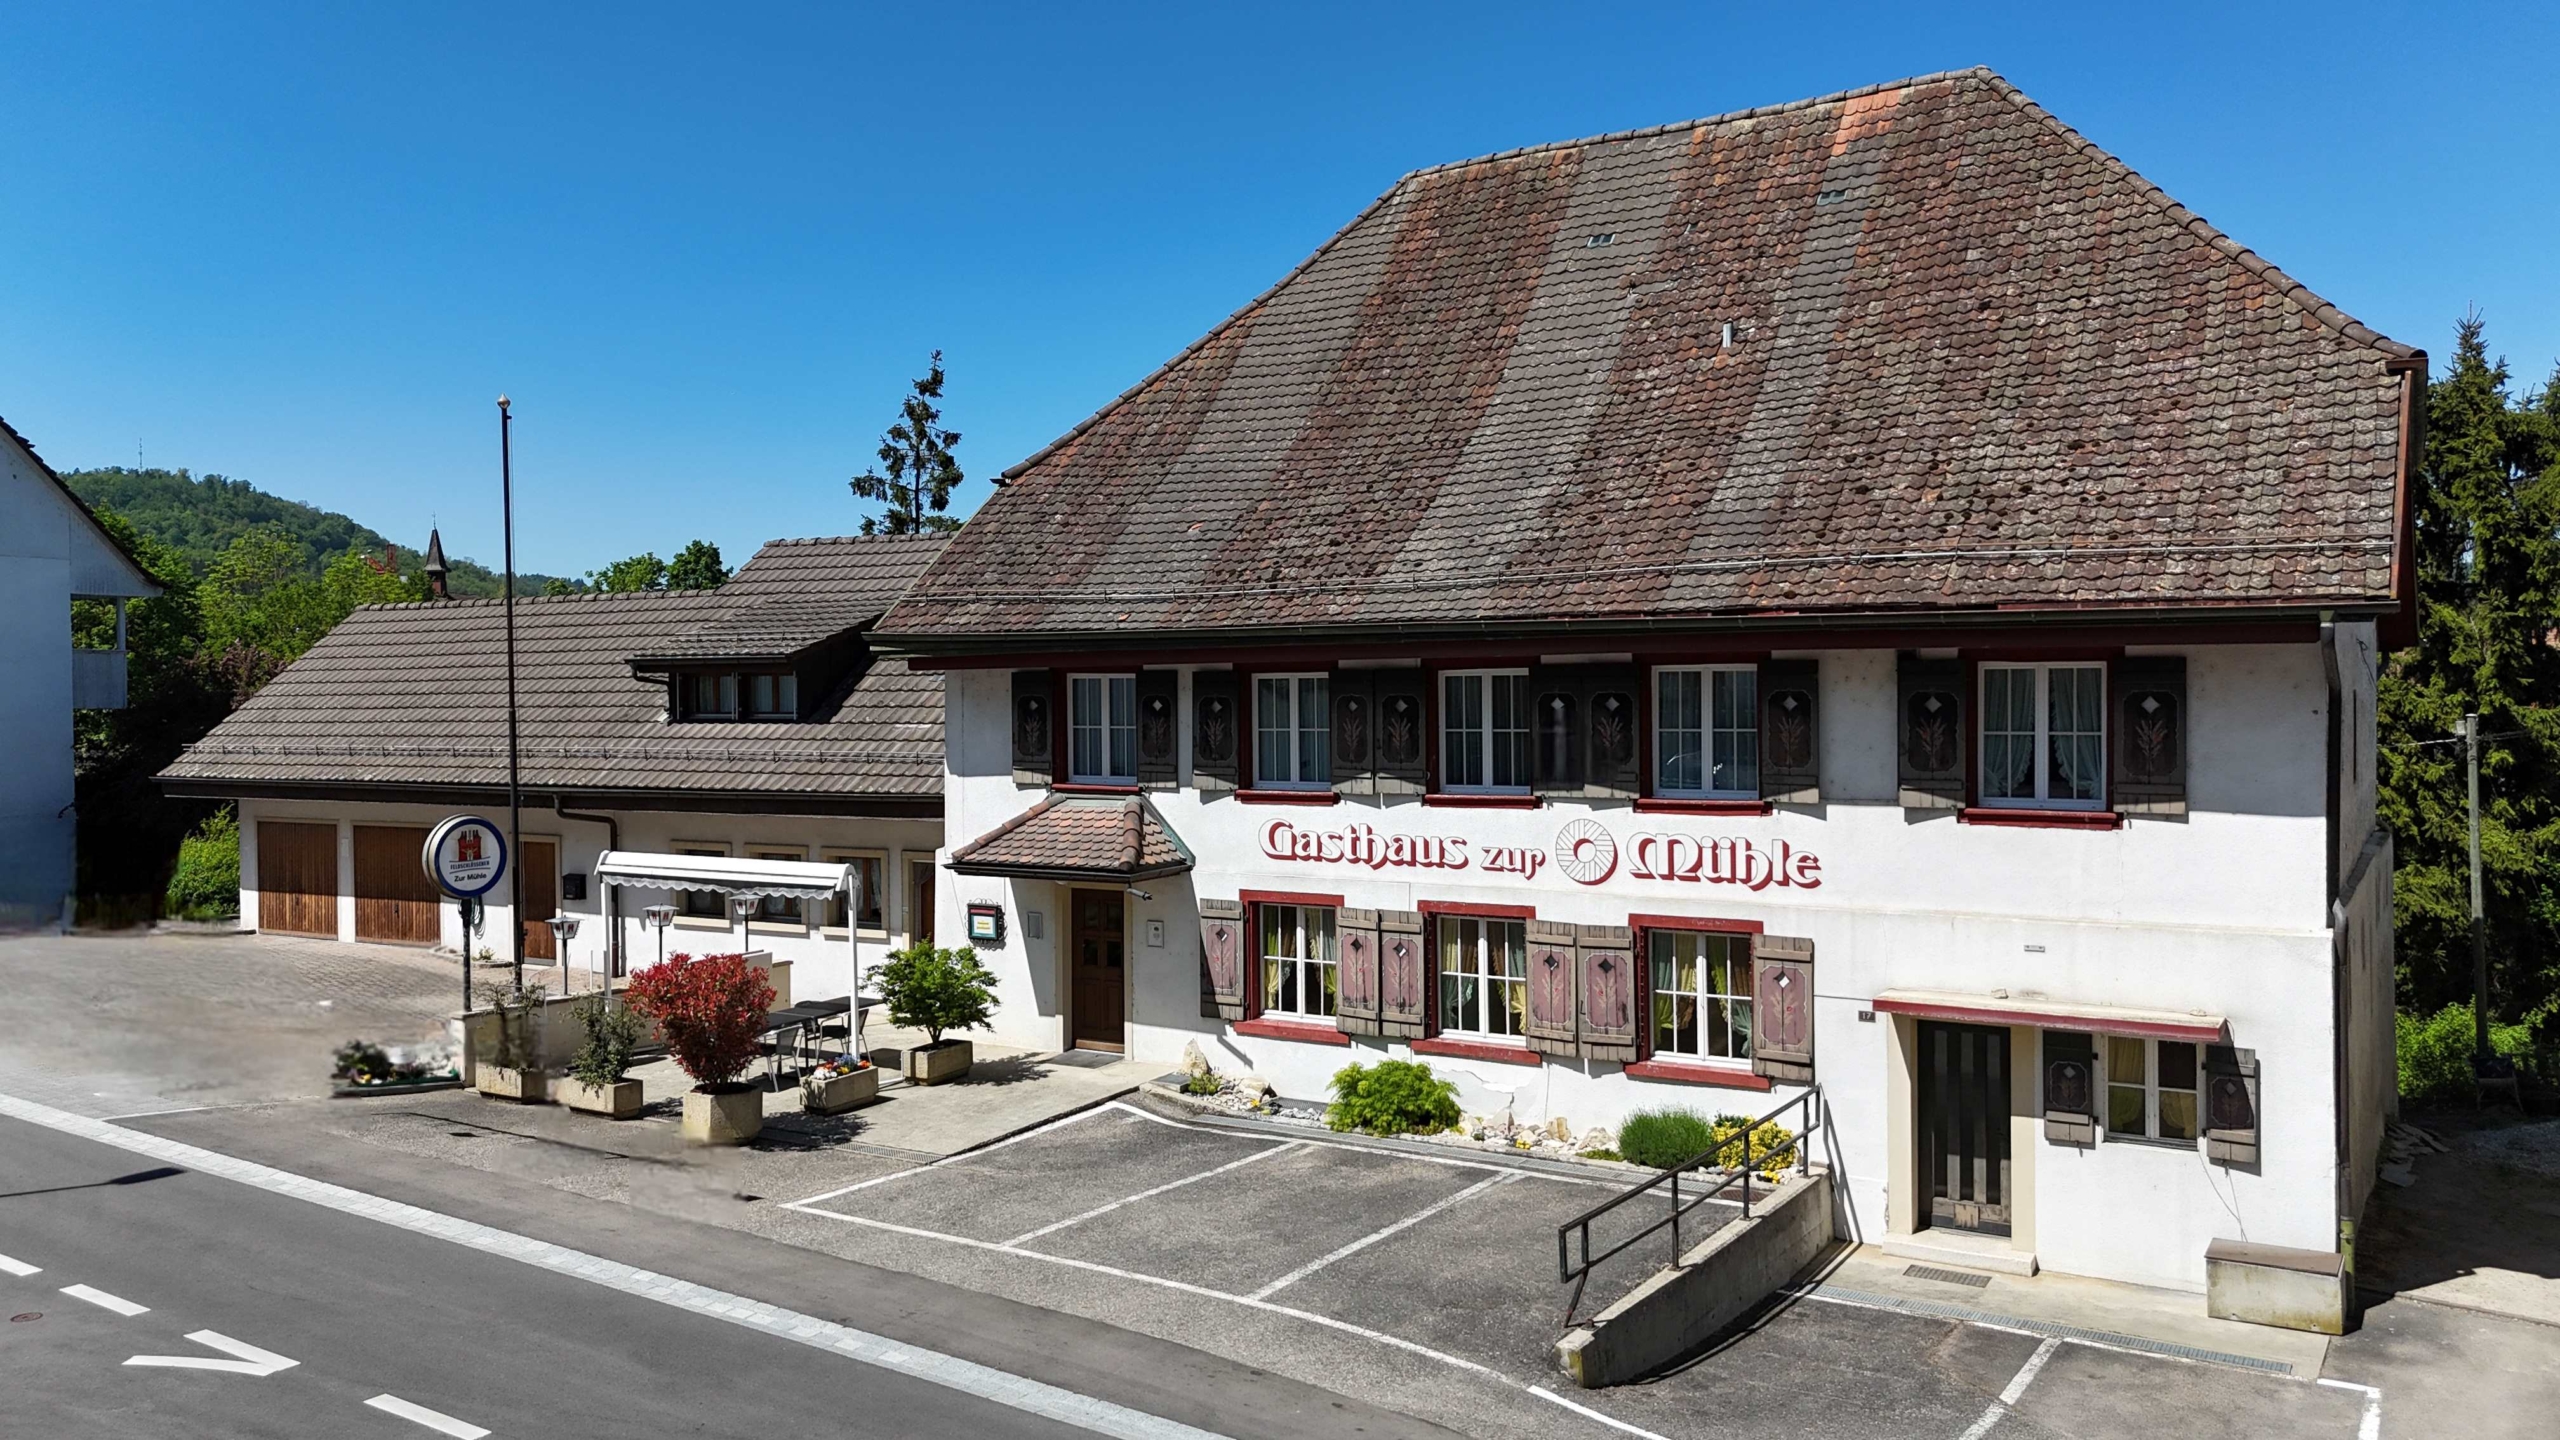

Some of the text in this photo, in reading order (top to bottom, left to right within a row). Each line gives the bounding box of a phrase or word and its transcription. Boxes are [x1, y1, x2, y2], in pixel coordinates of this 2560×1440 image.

[1258, 818, 1822, 891] Gasthaus zur Mühle
[1862, 1012, 1871, 1020] 17
